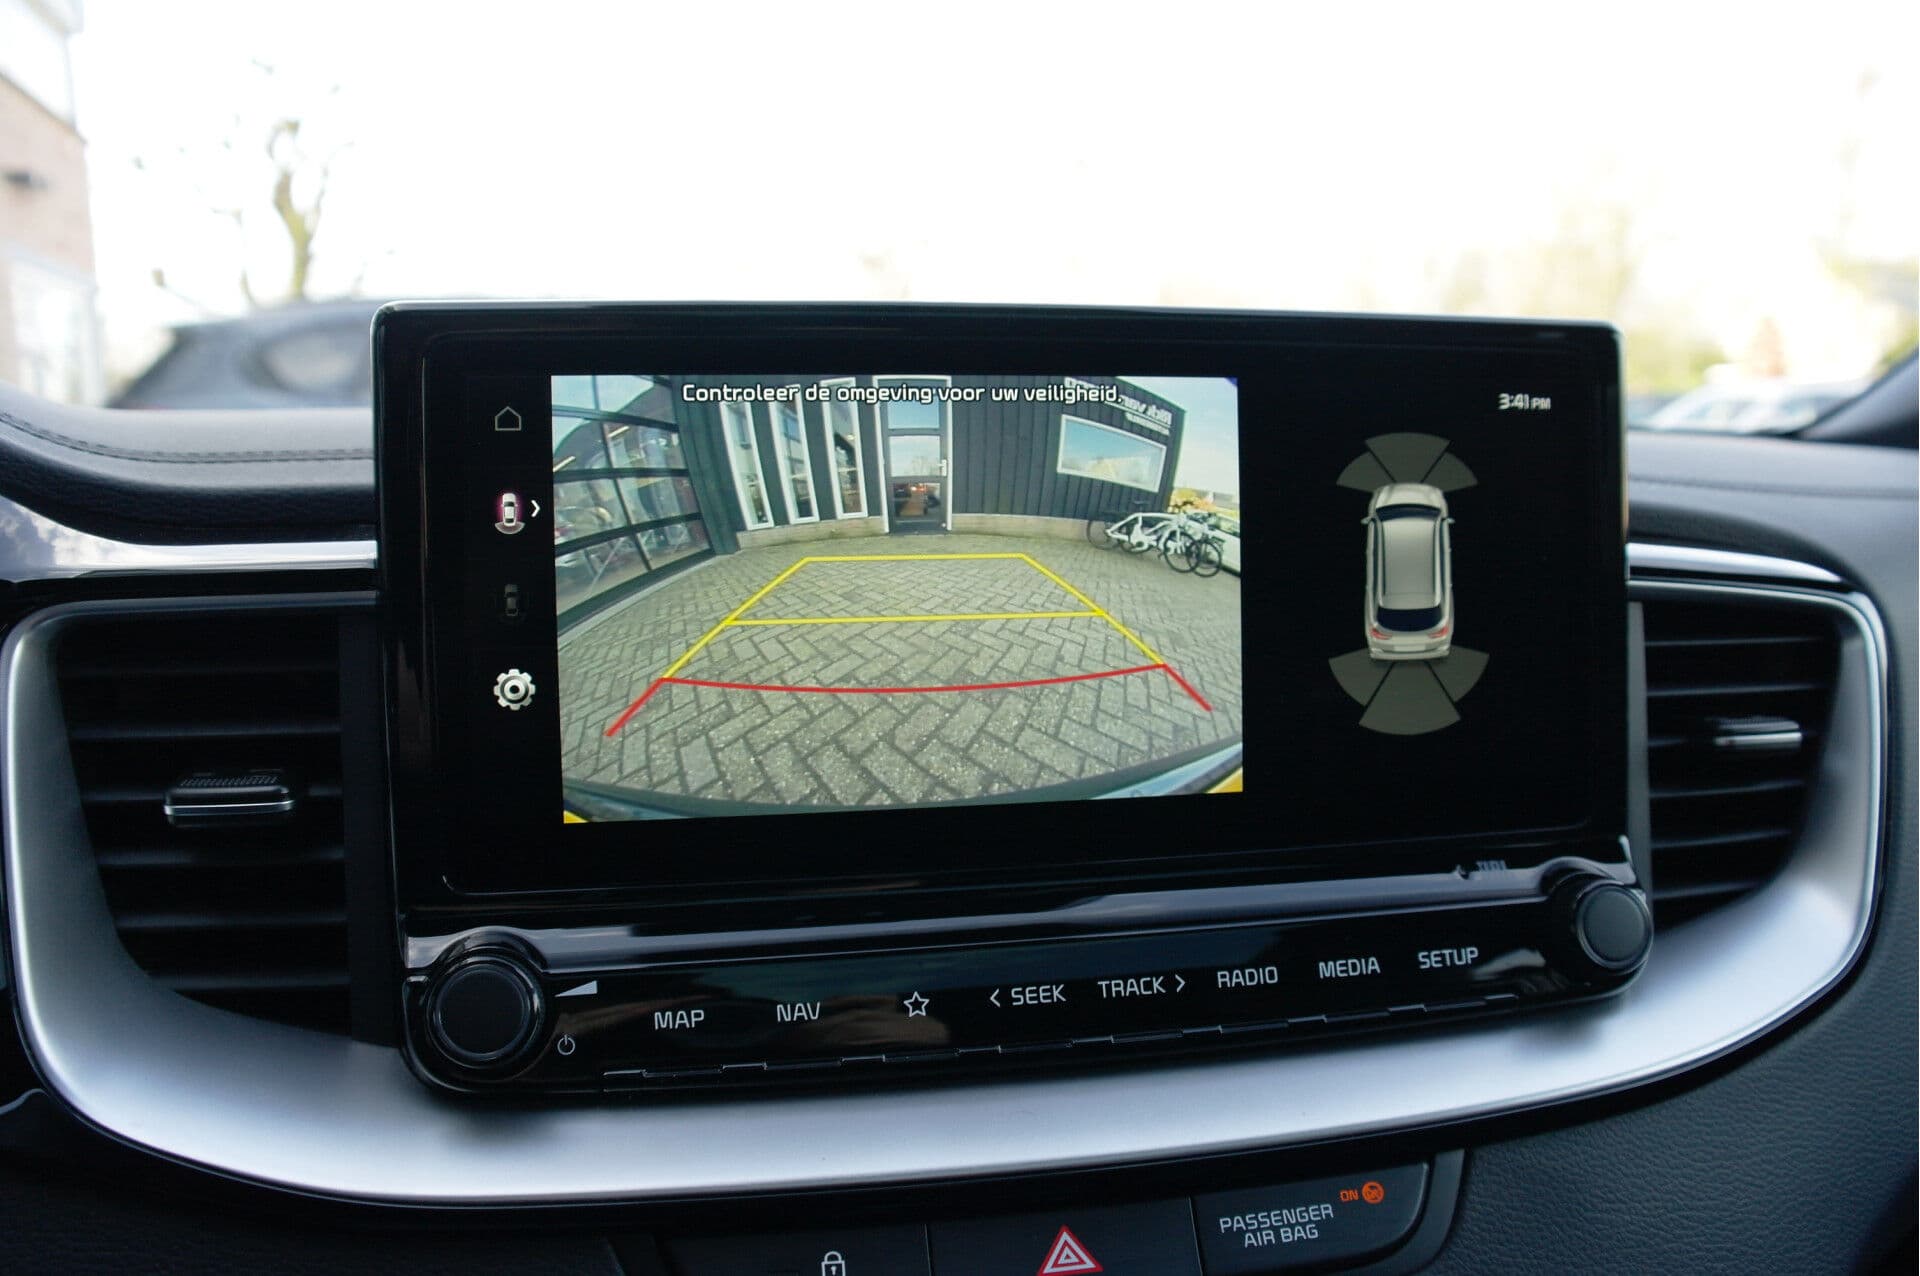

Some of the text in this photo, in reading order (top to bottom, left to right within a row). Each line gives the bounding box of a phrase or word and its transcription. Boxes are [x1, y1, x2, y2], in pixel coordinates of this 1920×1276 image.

[682, 384, 1122, 404] Controleer de omgeving voor uw veiligheid.
[1498, 392, 1551, 410] 3:41 PM
[1318, 956, 1381, 979] MEDIA
[1417, 946, 1479, 969] SETUP
[1097, 975, 1167, 999] TRACK
[1216, 966, 1279, 988] RADIO
[1010, 983, 1067, 1006] SEEK
[653, 1009, 706, 1030] MAP
[775, 1001, 822, 1023] NAV
[1340, 1189, 1360, 1202] ON
[1219, 1204, 1334, 1233] PASSENGER
[1244, 1224, 1319, 1248] AIR BAG
